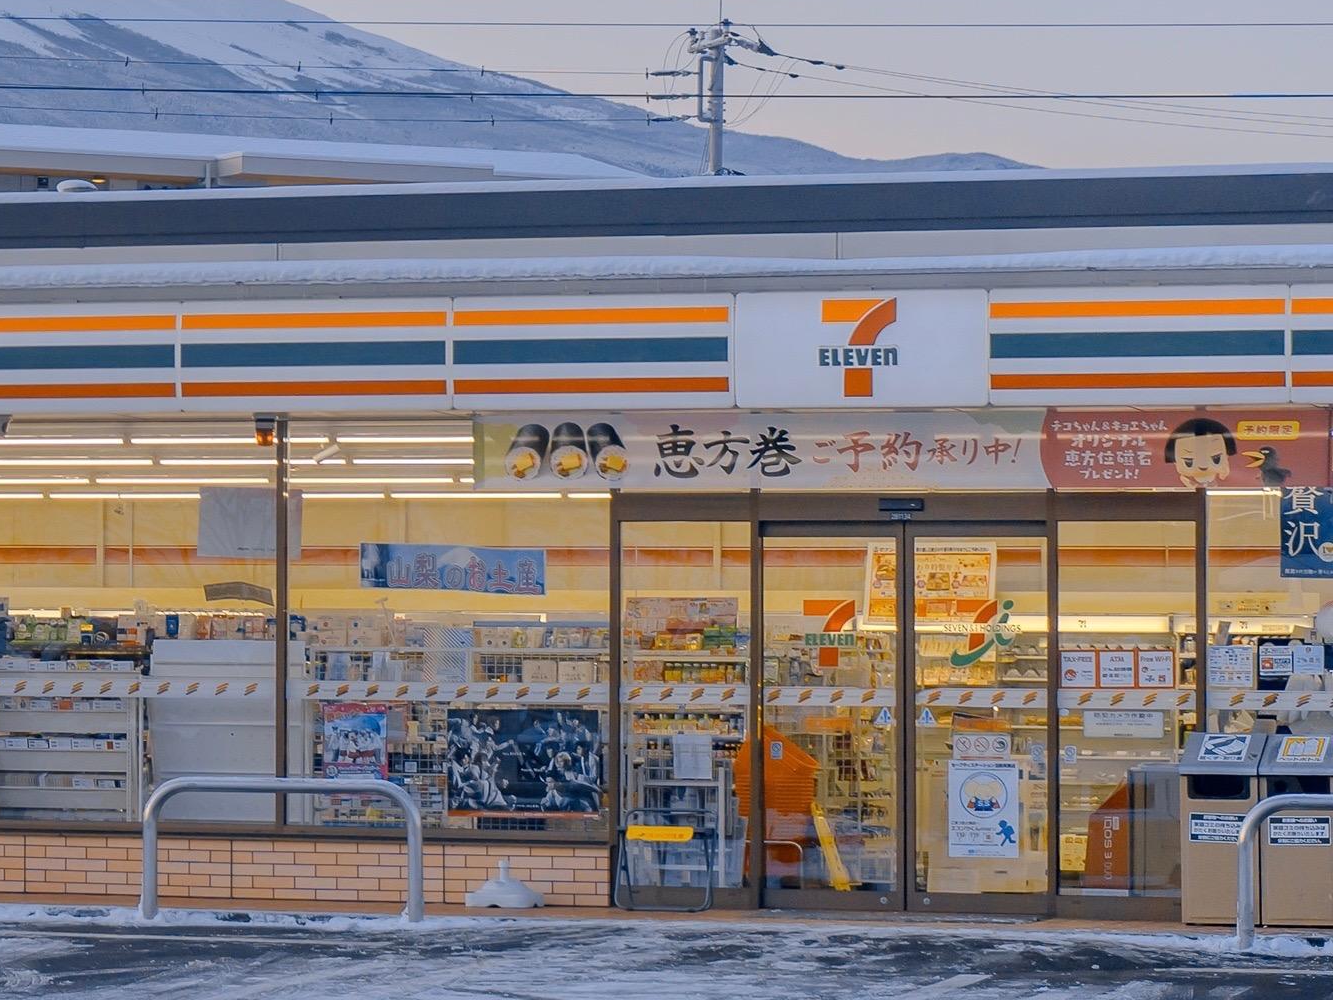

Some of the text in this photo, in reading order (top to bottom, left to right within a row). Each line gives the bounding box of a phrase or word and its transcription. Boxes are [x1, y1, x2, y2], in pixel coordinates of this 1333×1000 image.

[1243, 424, 1294, 436] 予約限定
[1070, 433, 1147, 448] オリジナル
[653, 423, 803, 480] 恵方巻
[1064, 449, 1152, 467] 恵方位磁石
[386, 552, 542, 595] 山梨のお土産
[944, 623, 970, 632] SEVEN
[980, 624, 1021, 632] HOLDINGS
